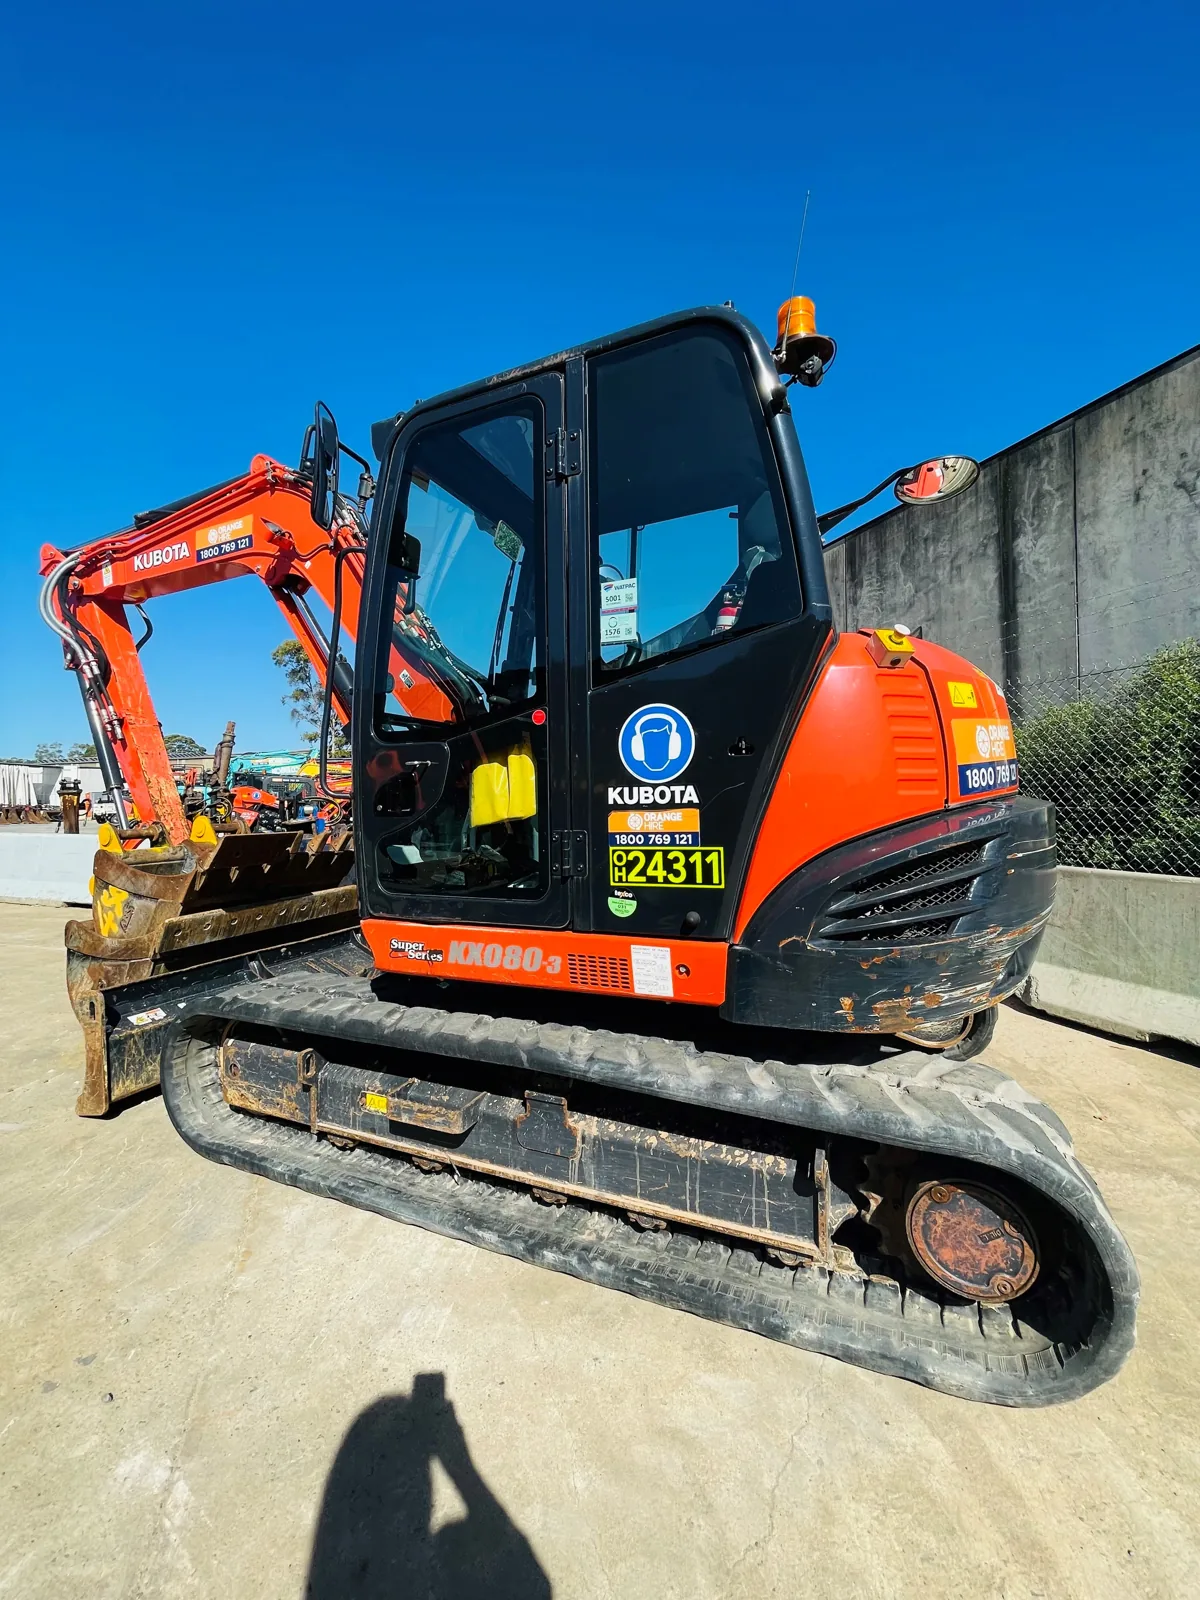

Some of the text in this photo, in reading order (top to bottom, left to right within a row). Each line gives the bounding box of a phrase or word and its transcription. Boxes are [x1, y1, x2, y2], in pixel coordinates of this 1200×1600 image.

[218, 521, 242, 533] ORANGE
[134, 542, 190, 571] KUBOTA
[200, 538, 249, 559] 1800 769 121
[965, 766, 995, 789] 1800
[996, 764, 1010, 784] 769
[608, 785, 700, 805] KUBOTA
[643, 812, 683, 822] ORANGE
[643, 821, 665, 831] HIRE
[614, 834, 692, 845] 1800 769 121
[627, 850, 720, 884] 24311
[390, 938, 425, 951] Super
[407, 949, 444, 963] Series
[447, 940, 562, 975] KX080-3
